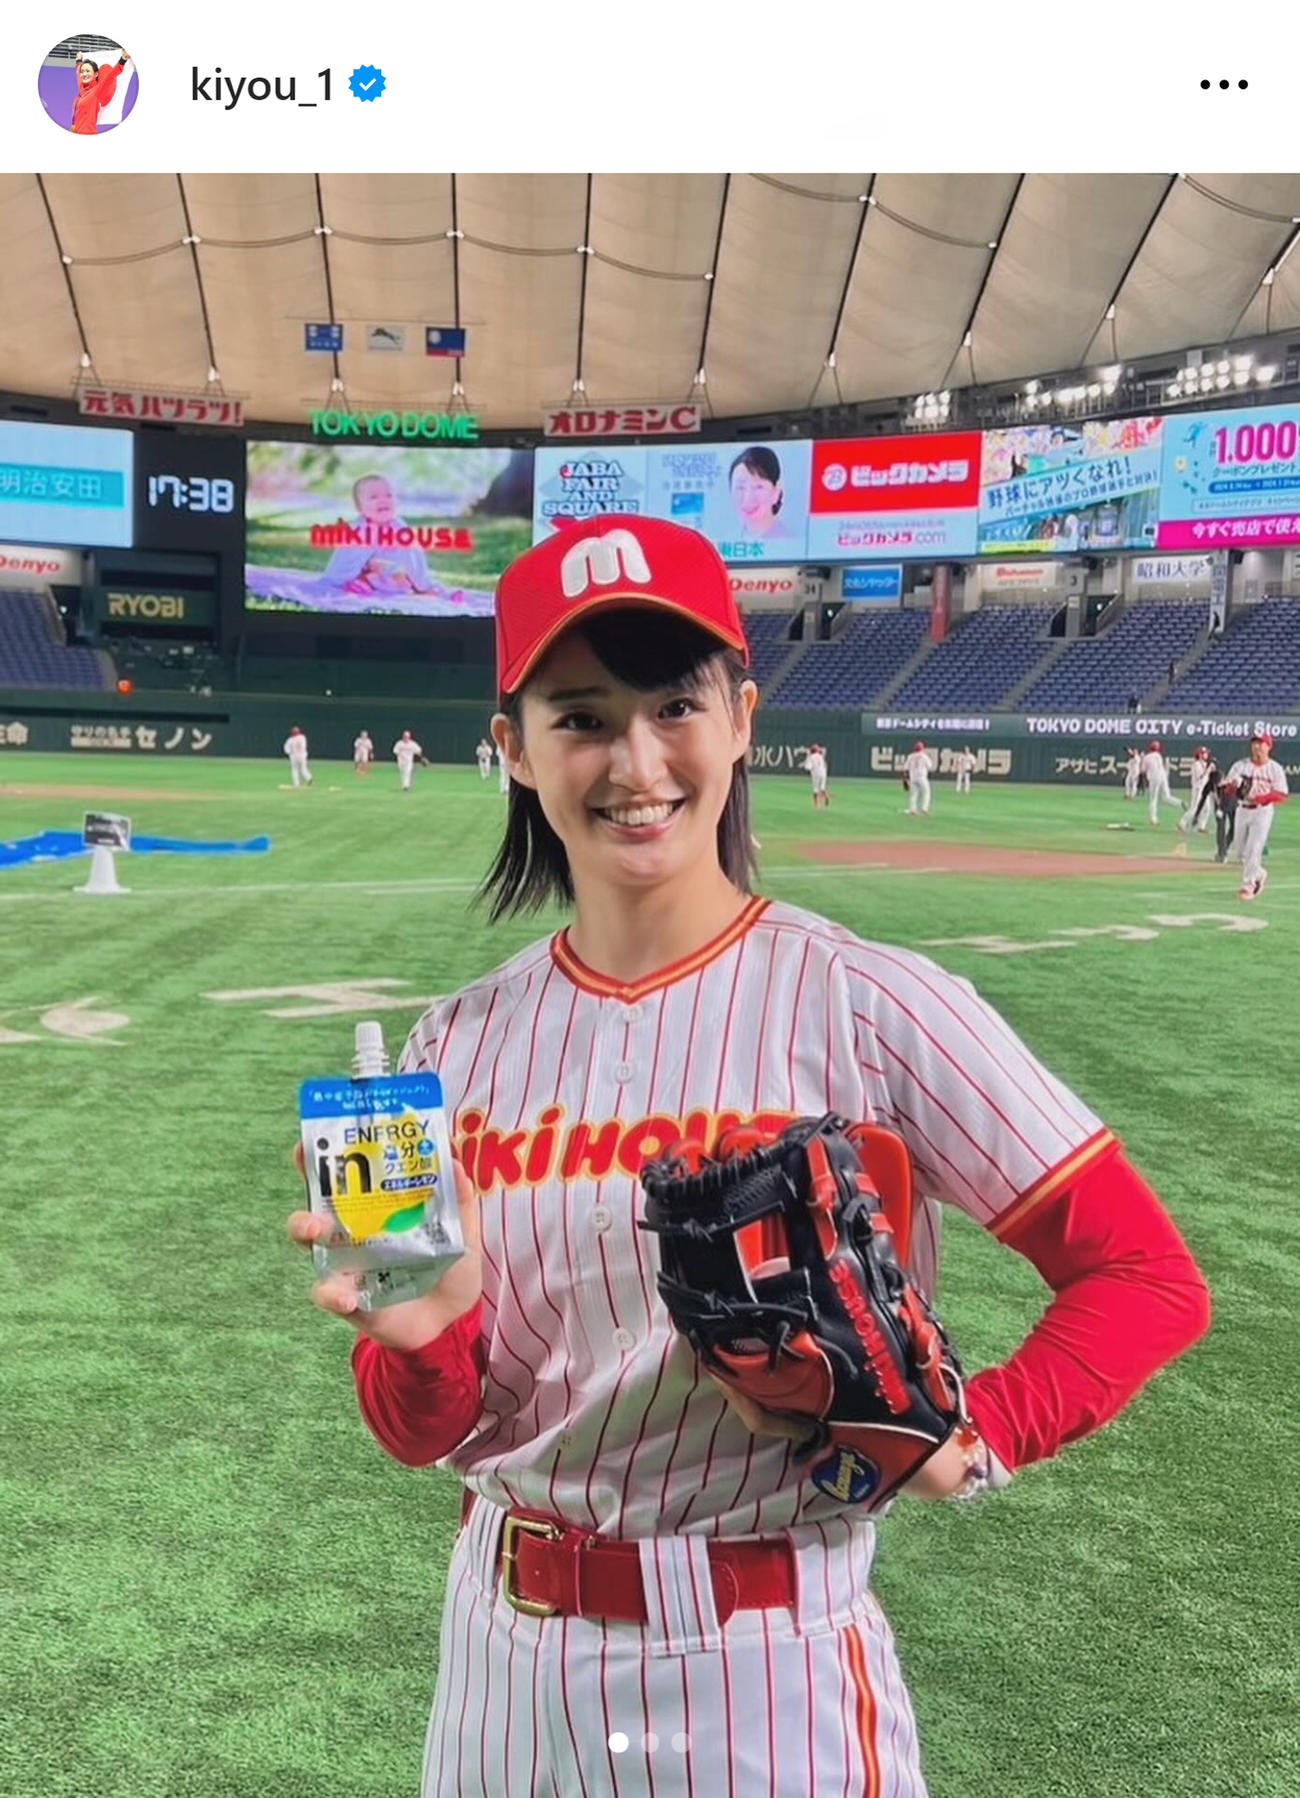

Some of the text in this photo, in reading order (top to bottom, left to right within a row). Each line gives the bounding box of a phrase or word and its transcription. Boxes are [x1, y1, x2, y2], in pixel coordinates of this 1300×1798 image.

[82, 389, 242, 424] 元気ハツラツ!
[550, 406, 697, 434] オロナミンC
[310, 410, 479, 439] TOKYO DOME
[560, 460, 624, 477] JABA
[986, 455, 1132, 509] 野球にアツくなれ!
[0, 472, 101, 500] 明治安田
[149, 474, 234, 513] 17:38
[562, 478, 619, 492] FAIR
[568, 491, 613, 502] AND
[542, 501, 639, 517] SQUARE
[1136, 559, 1206, 580] 昭和大学
[107, 592, 185, 619] RYOBI
[135, 725, 213, 750] セノン
[1026, 717, 1298, 738] TOKYO DOME CITY e-Ticket Store
[316, 1137, 372, 1198] in
